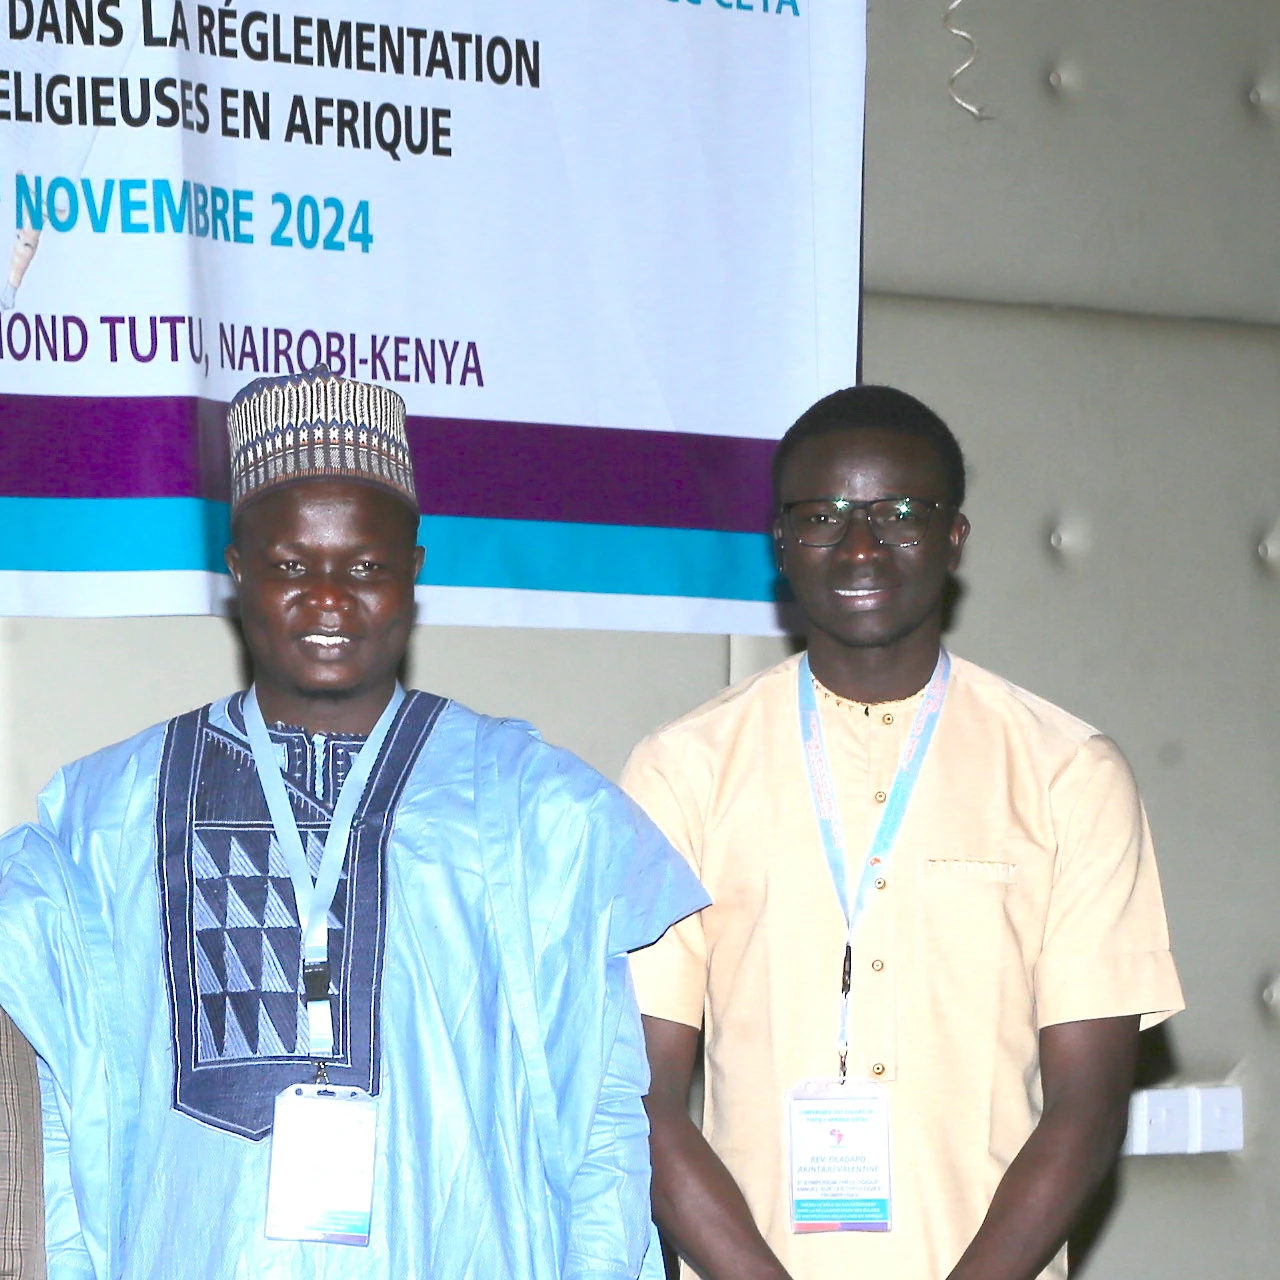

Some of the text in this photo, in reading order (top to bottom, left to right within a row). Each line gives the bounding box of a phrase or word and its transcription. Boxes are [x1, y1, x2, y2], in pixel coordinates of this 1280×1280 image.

[9, 0, 123, 47] DANS
[142, 0, 190, 51] LA
[198, 3, 539, 88] RÉGLEMENTATION
[221, 87, 269, 140] EN
[285, 95, 451, 161] AFRIQUE
[16, 174, 254, 244] NOVEMBRE
[271, 192, 374, 253] 2024
[100, 316, 208, 375] TUTU,
[219, 322, 483, 387] NAIROBI-KENYA
